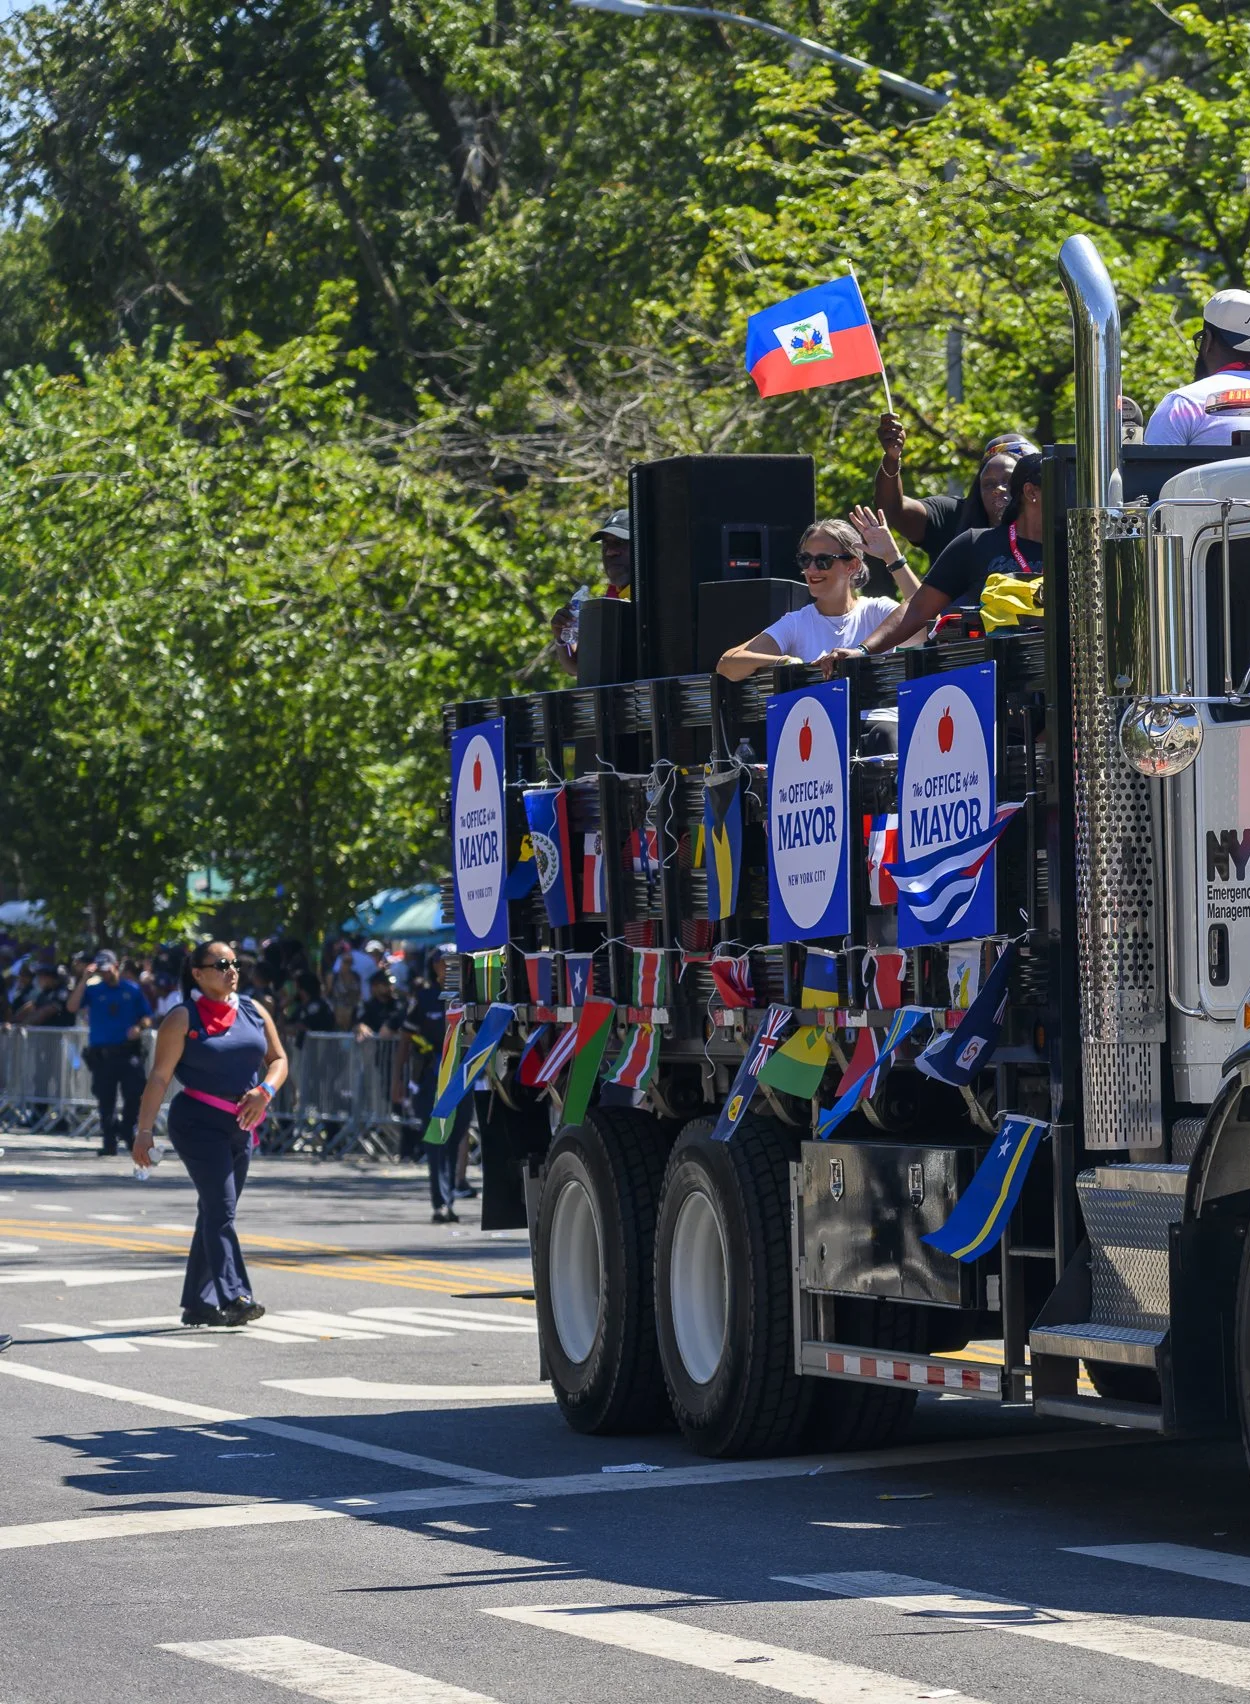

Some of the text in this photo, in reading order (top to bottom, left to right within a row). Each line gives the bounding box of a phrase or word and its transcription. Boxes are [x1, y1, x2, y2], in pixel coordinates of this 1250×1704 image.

[779, 780, 833, 804] The OFFICE of the
[912, 771, 979, 798] The OFFICE of the
[466, 808, 486, 829] OFFICE
[777, 805, 837, 851] MAYOR
[910, 797, 983, 848] MAYOR
[460, 830, 499, 870] MAYOR
[788, 869, 827, 886] NEW YORK CITY
[467, 886, 493, 900] NEW YORK CITY
